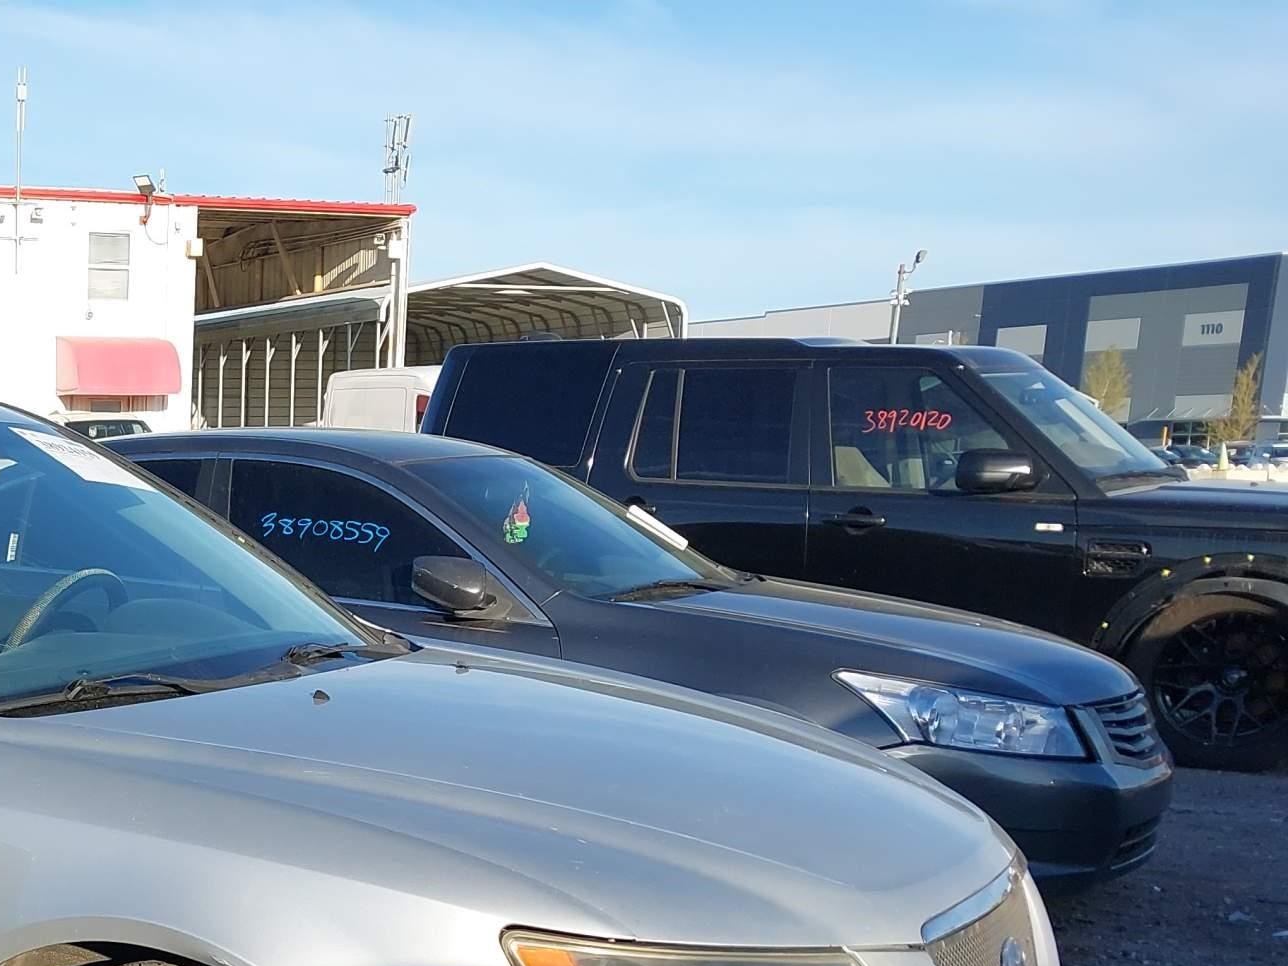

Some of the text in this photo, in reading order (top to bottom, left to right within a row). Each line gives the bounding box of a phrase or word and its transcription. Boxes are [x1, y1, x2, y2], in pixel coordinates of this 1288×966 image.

[1200, 322, 1224, 336] 1110
[861, 408, 952, 433] 38920120
[261, 512, 391, 552] 38908559
